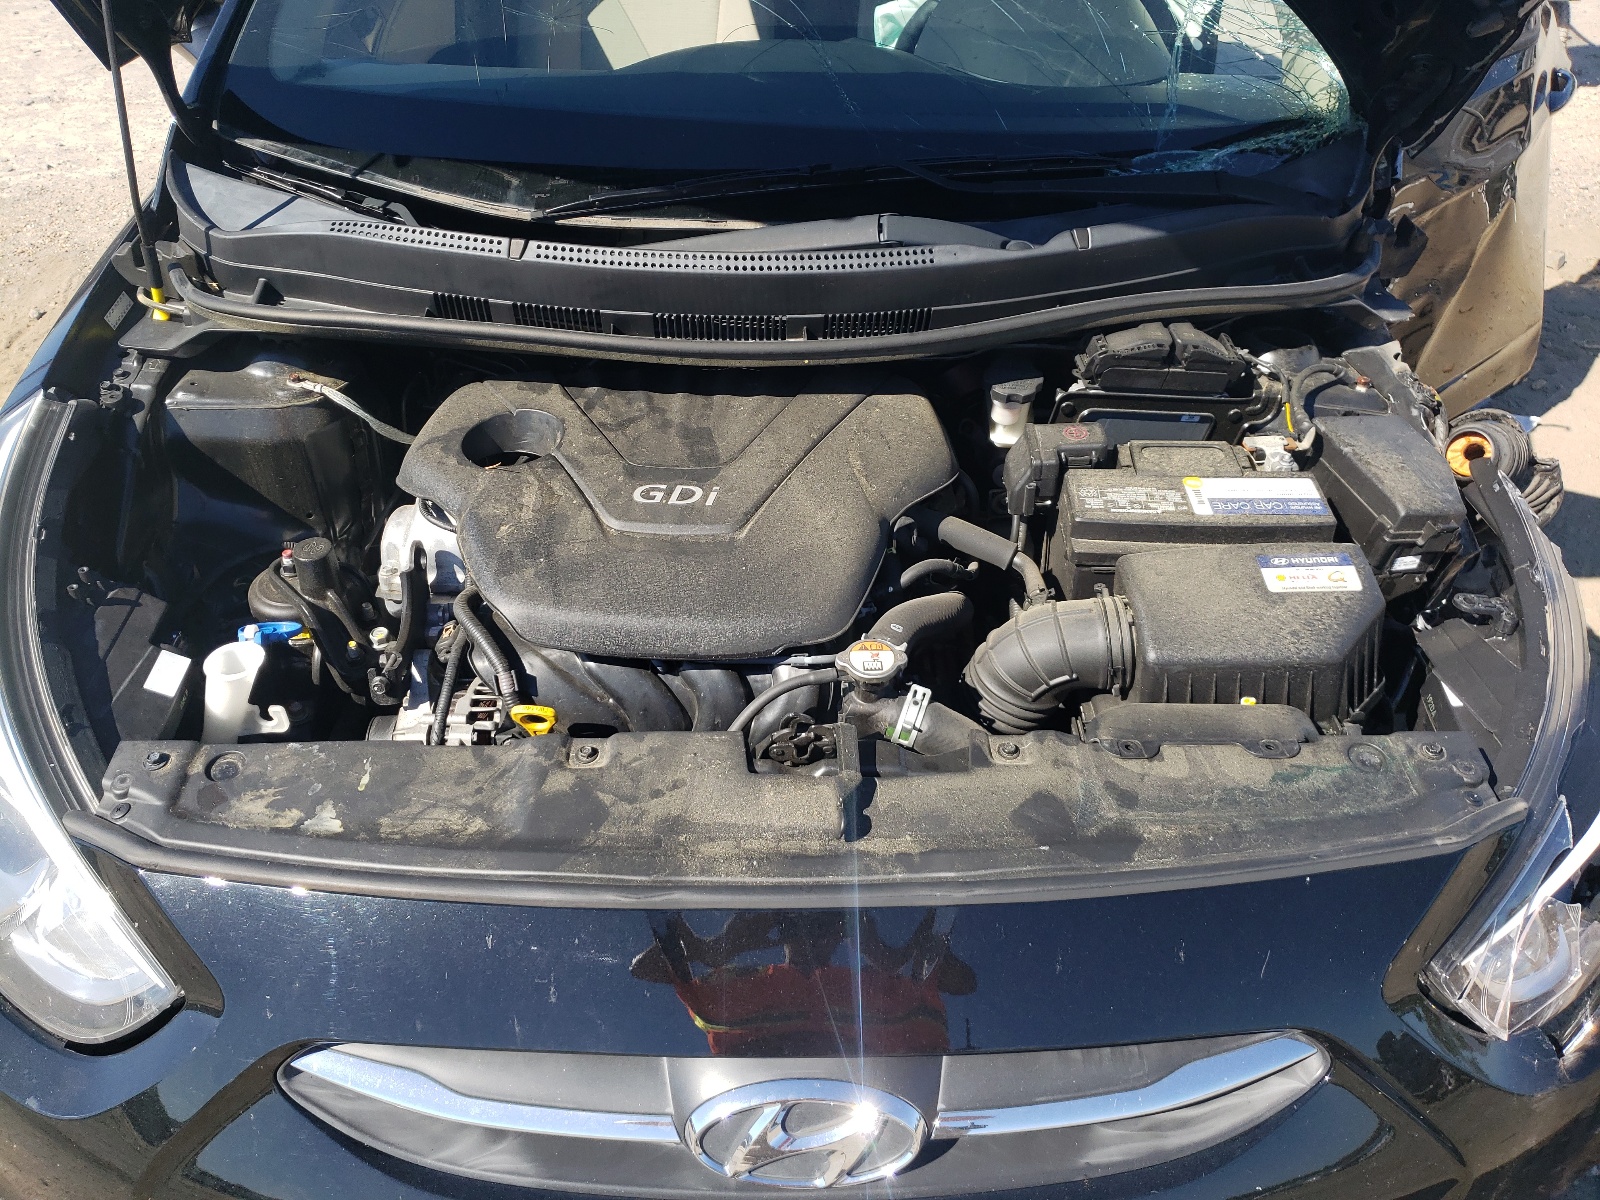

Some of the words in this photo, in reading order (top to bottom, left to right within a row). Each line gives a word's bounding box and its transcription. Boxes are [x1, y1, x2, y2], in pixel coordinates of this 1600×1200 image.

[632, 484, 721, 506] GDi
[1212, 501, 1250, 510] CARE
[1254, 501, 1284, 511] CAR
[1290, 556, 1339, 564] HYUNDAI
